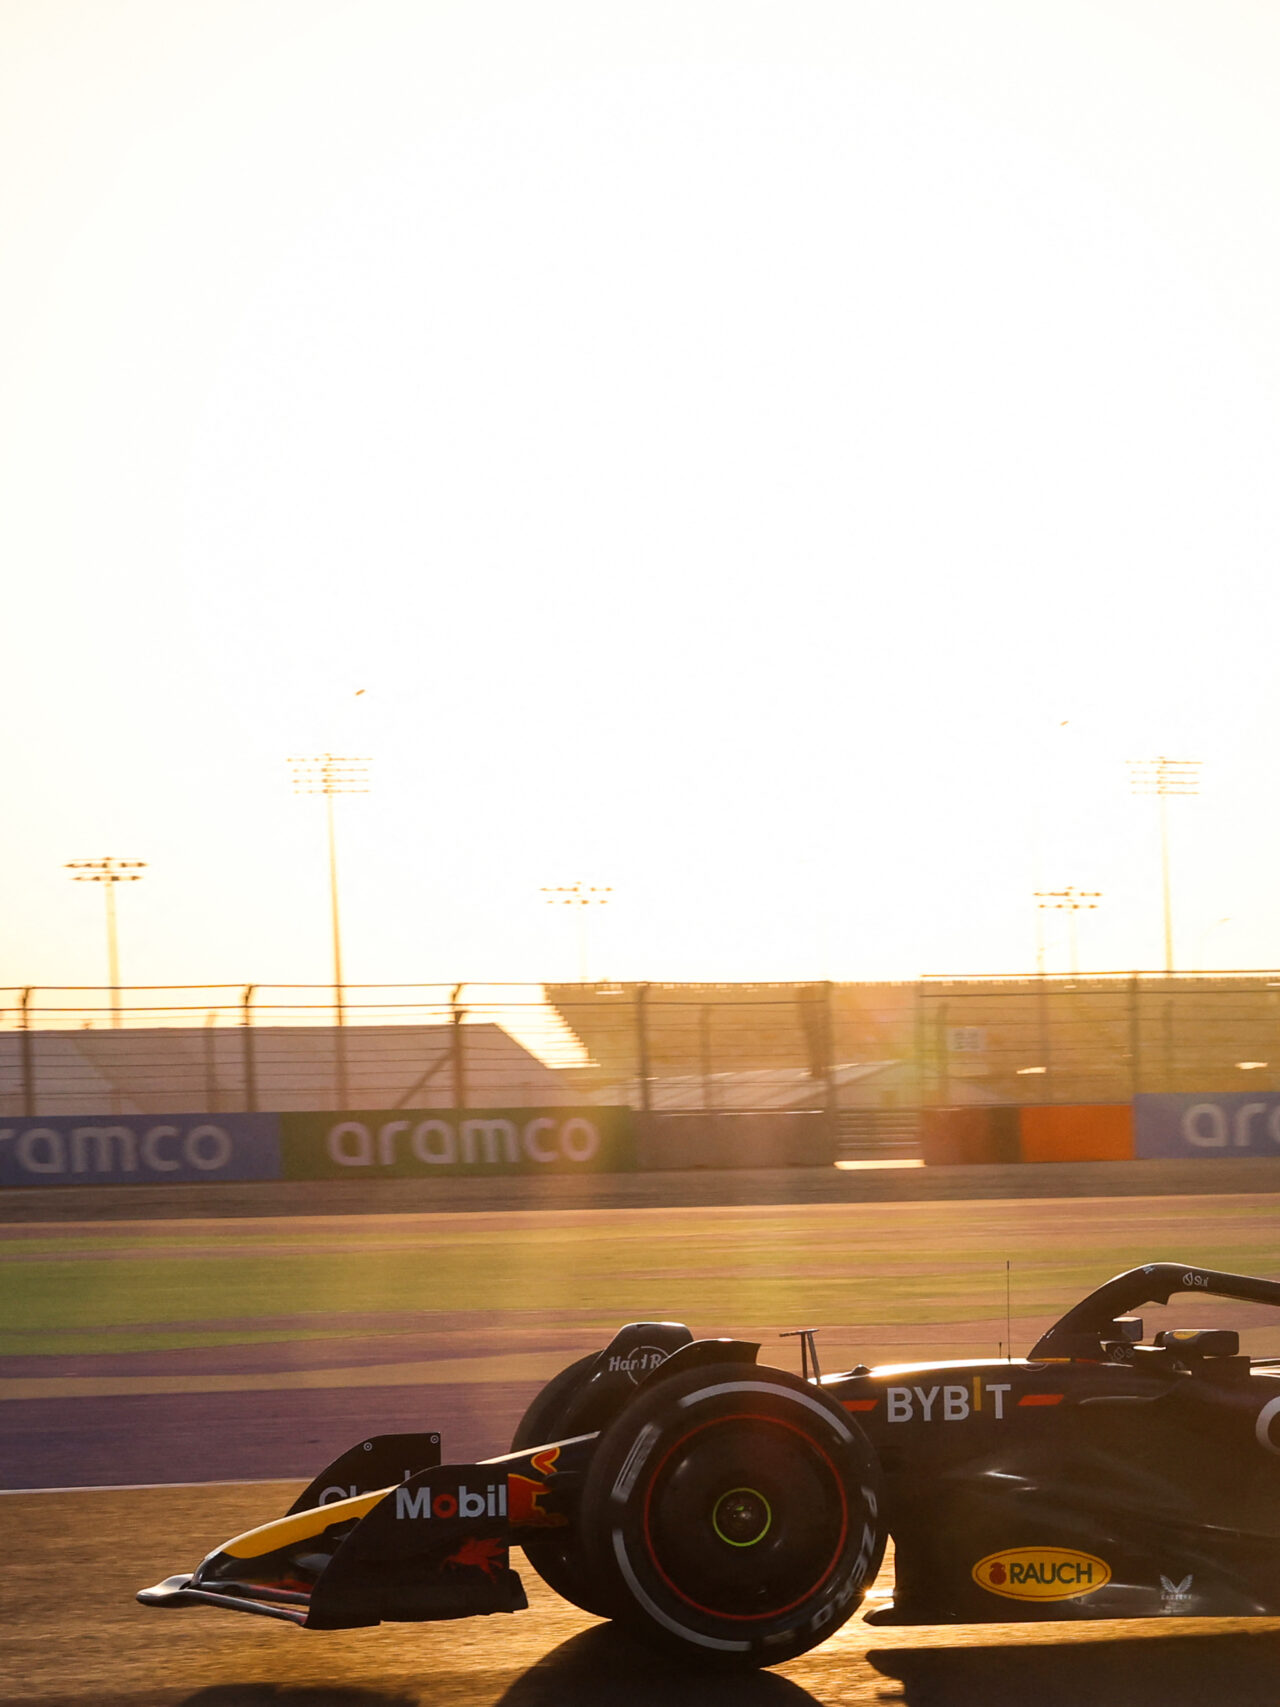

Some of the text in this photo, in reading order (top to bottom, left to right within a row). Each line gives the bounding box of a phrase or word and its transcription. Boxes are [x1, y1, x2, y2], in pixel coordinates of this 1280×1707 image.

[327, 1117, 599, 1166] aramco
[887, 1376, 1012, 1422] BYBIT
[396, 1484, 507, 1519] Mobil
[1009, 1562, 1093, 1585] RAUCH
